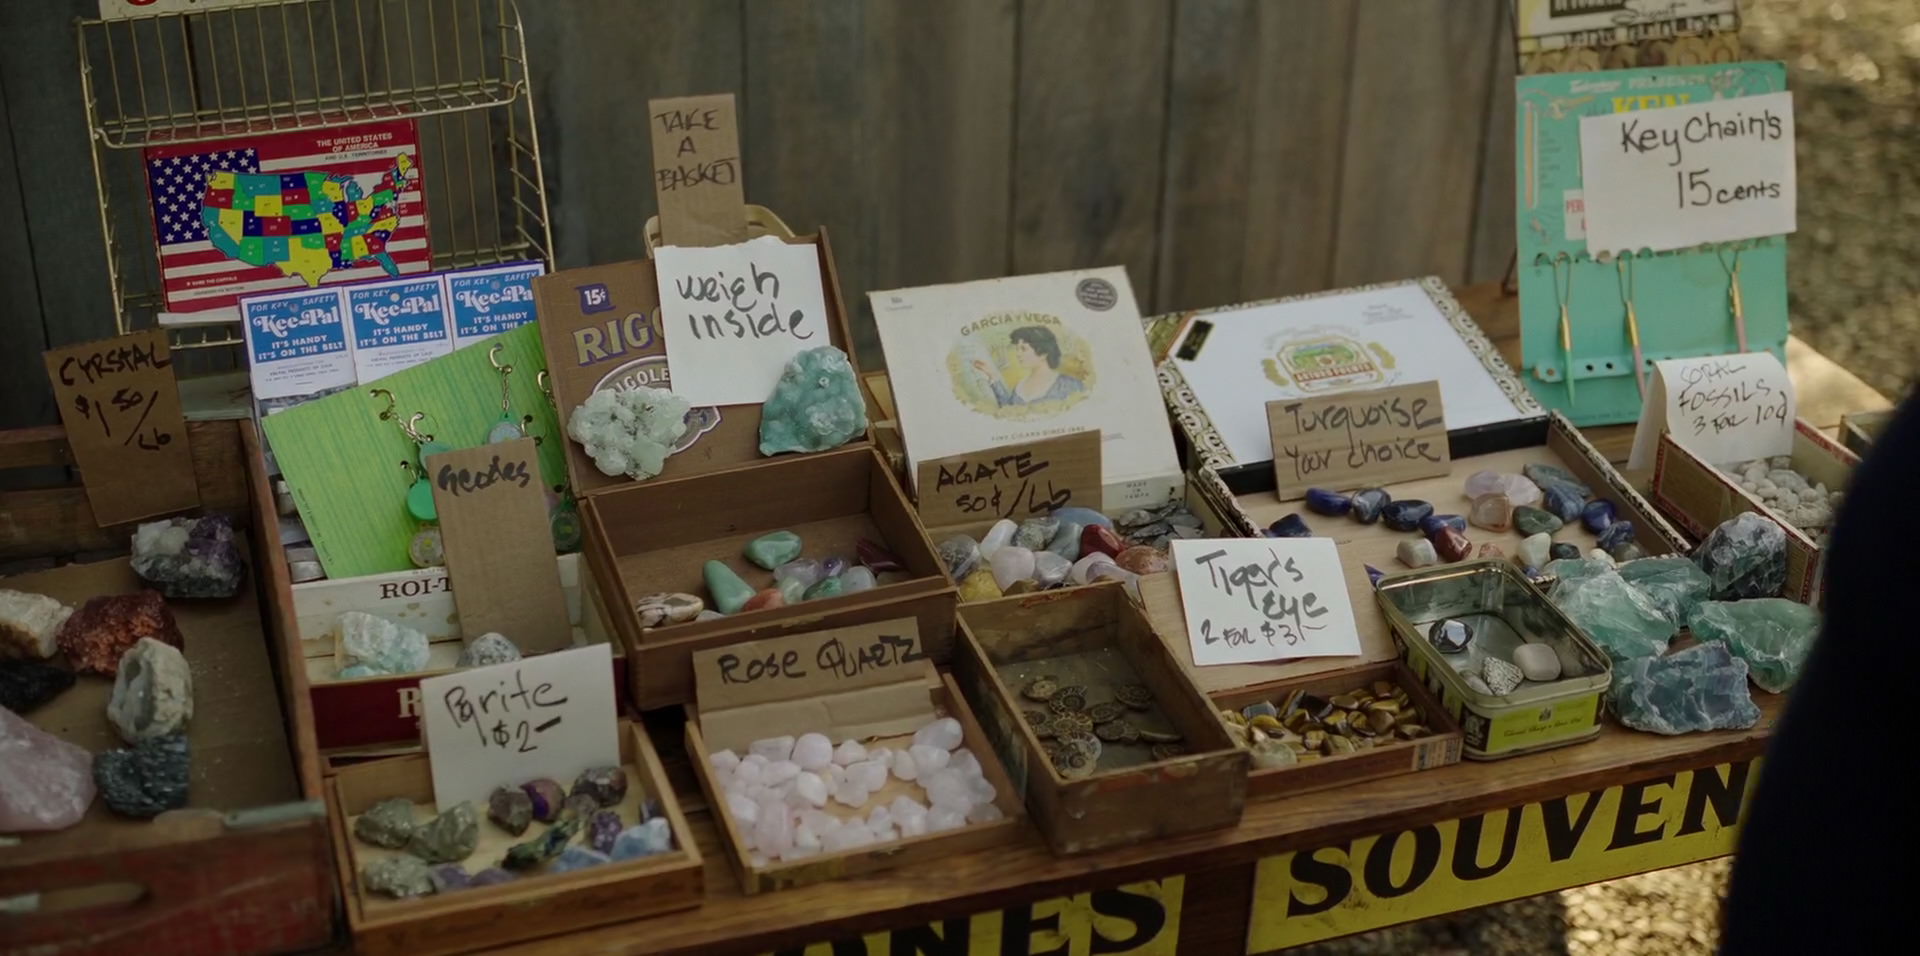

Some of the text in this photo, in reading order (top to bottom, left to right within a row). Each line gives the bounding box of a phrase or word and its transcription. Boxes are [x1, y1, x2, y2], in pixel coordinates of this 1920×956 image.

[653, 108, 720, 133] TAKE
[316, 132, 393, 148] THE UNITED STATES
[677, 136, 696, 158] A
[404, 282, 437, 293] SAFETY
[584, 288, 606, 306] 15¢
[676, 262, 780, 313] weigh
[302, 294, 336, 305] SAFETY
[494, 312, 528, 322] HANDY
[961, 313, 1013, 337] GARCIA
[1024, 312, 1061, 326] VEGA
[382, 336, 397, 344] ON
[402, 333, 419, 341] THE
[423, 330, 443, 339] BELT
[394, 323, 429, 333] HANDY
[482, 324, 497, 332] ON
[281, 349, 296, 357] ON
[300, 345, 318, 354] THE
[322, 341, 343, 351] BELT
[292, 335, 328, 346] HANDY
[1678, 378, 1772, 416] FOSSILS
[1285, 399, 1443, 451] Turquoise
[1693, 416, 1706, 436] 3
[936, 451, 1049, 491] AGATE
[1195, 547, 1304, 611] Tiger's
[1201, 618, 1220, 646] 2
